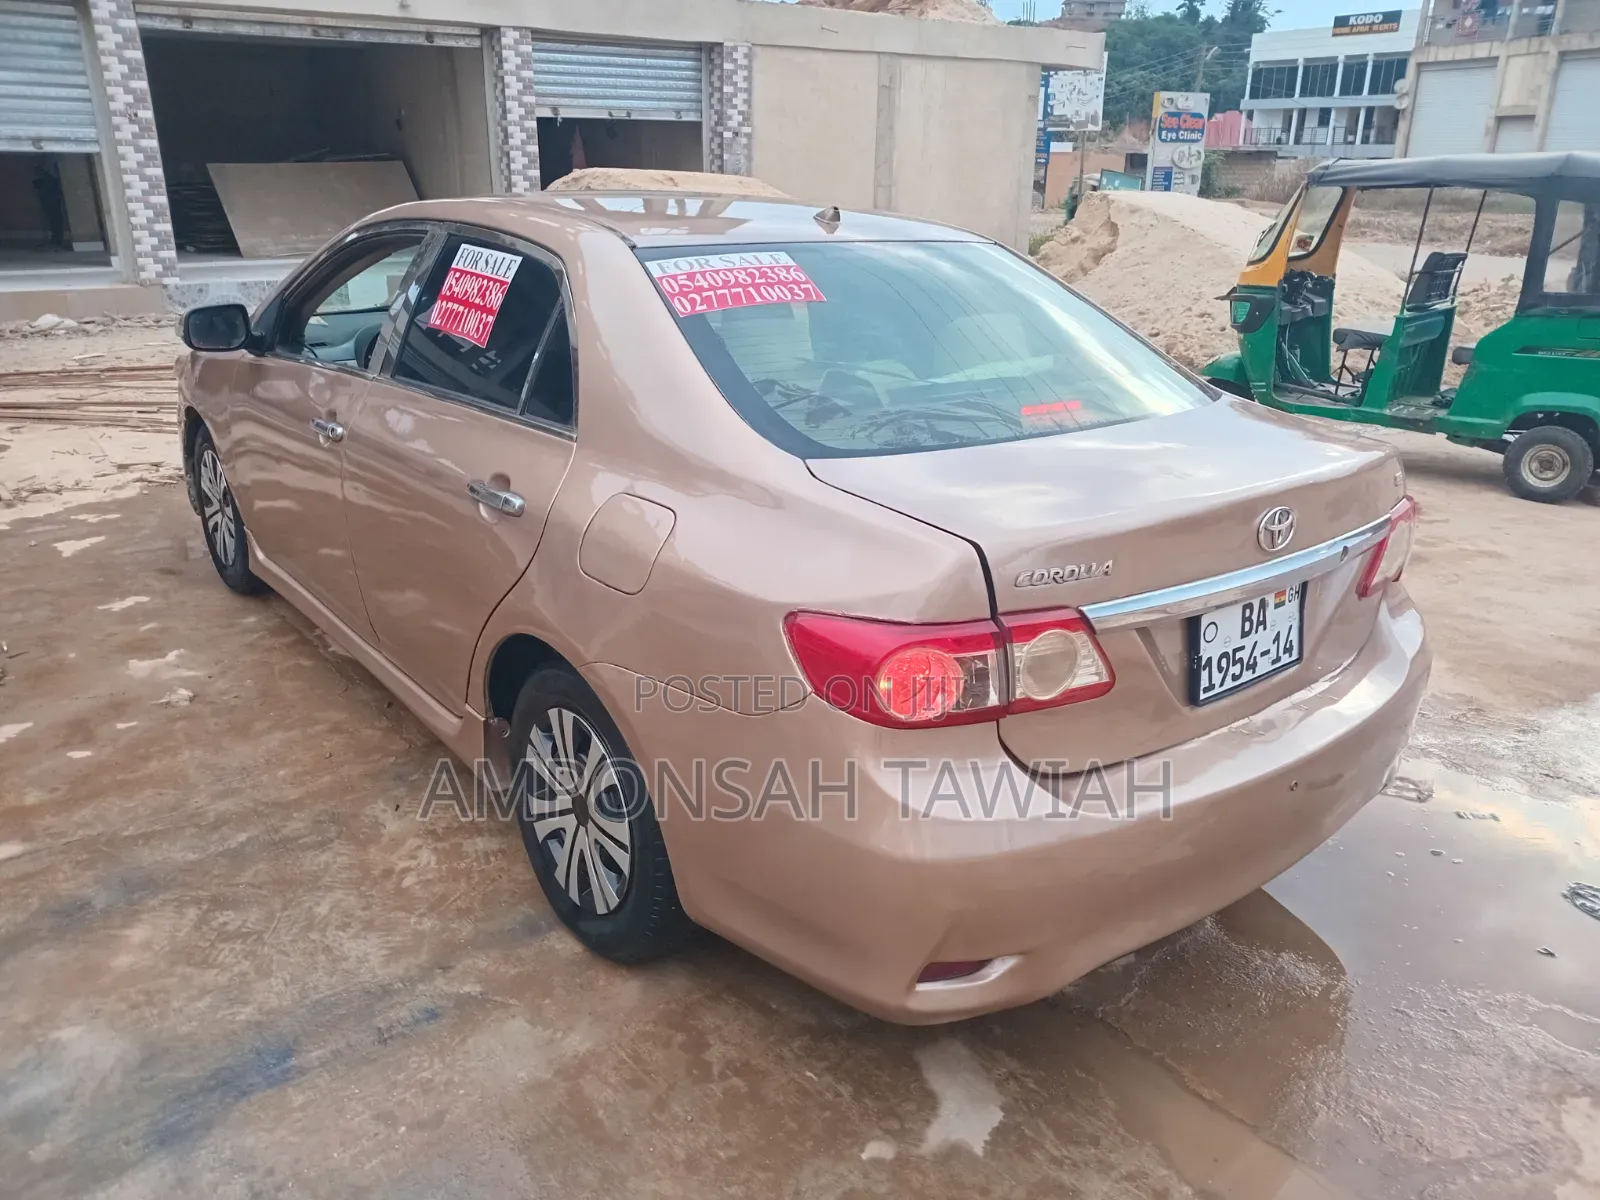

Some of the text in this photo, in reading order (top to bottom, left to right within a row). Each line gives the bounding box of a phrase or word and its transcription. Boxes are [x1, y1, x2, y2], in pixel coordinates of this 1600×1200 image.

[1349, 14, 1383, 25] KODO
[1161, 113, 1205, 129] See Clear
[1161, 130, 1202, 141] Eye Clinic
[456, 248, 517, 279] FOR SALE
[656, 253, 789, 275] FOR SALE
[442, 271, 508, 310] 0540982386
[662, 266, 806, 294] 0540982386
[674, 284, 817, 314] 0277710037
[430, 300, 494, 342] 0277710037
[1014, 559, 1112, 587] COROLLA
[1240, 584, 1300, 640] BA GH
[1202, 624, 1294, 694] 1954-14
